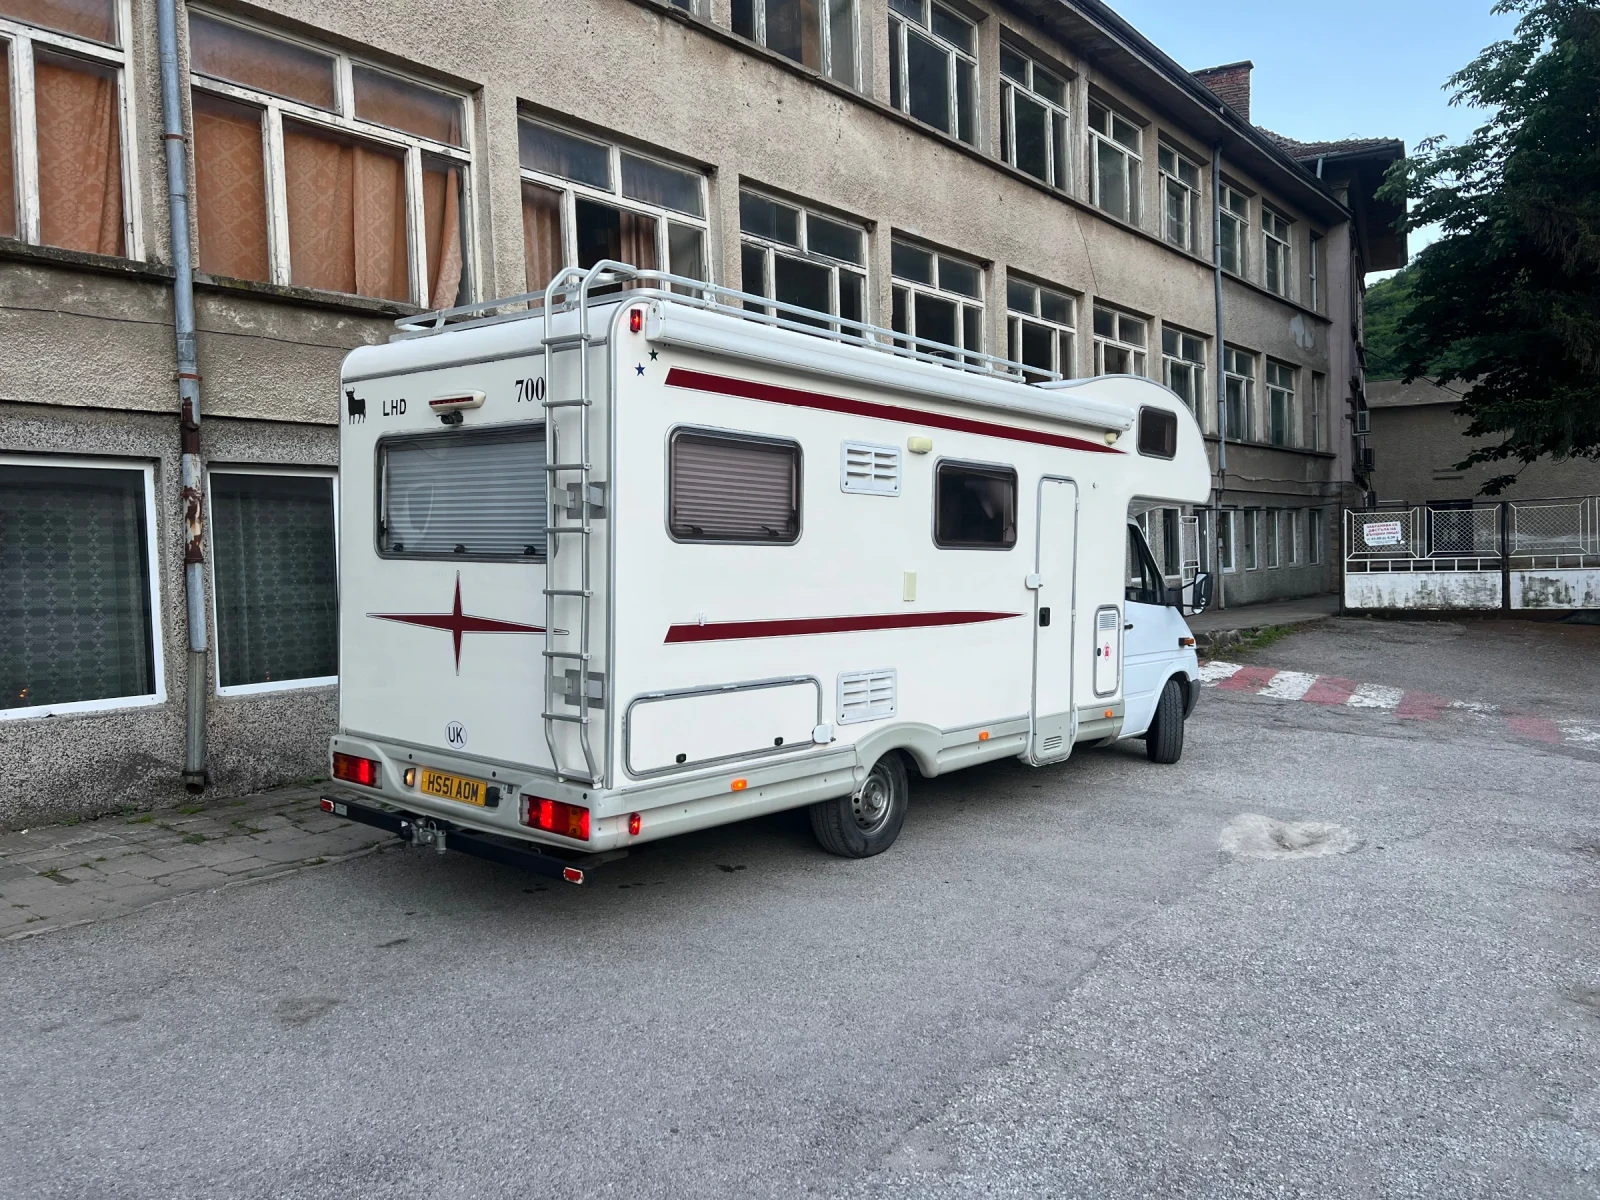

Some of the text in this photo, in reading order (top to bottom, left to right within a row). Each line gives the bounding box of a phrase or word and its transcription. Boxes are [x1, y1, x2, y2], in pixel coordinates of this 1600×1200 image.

[515, 377, 545, 402] 700
[383, 398, 407, 417] LHD
[448, 726, 464, 744] UK
[427, 773, 479, 802] HS51 AOM
